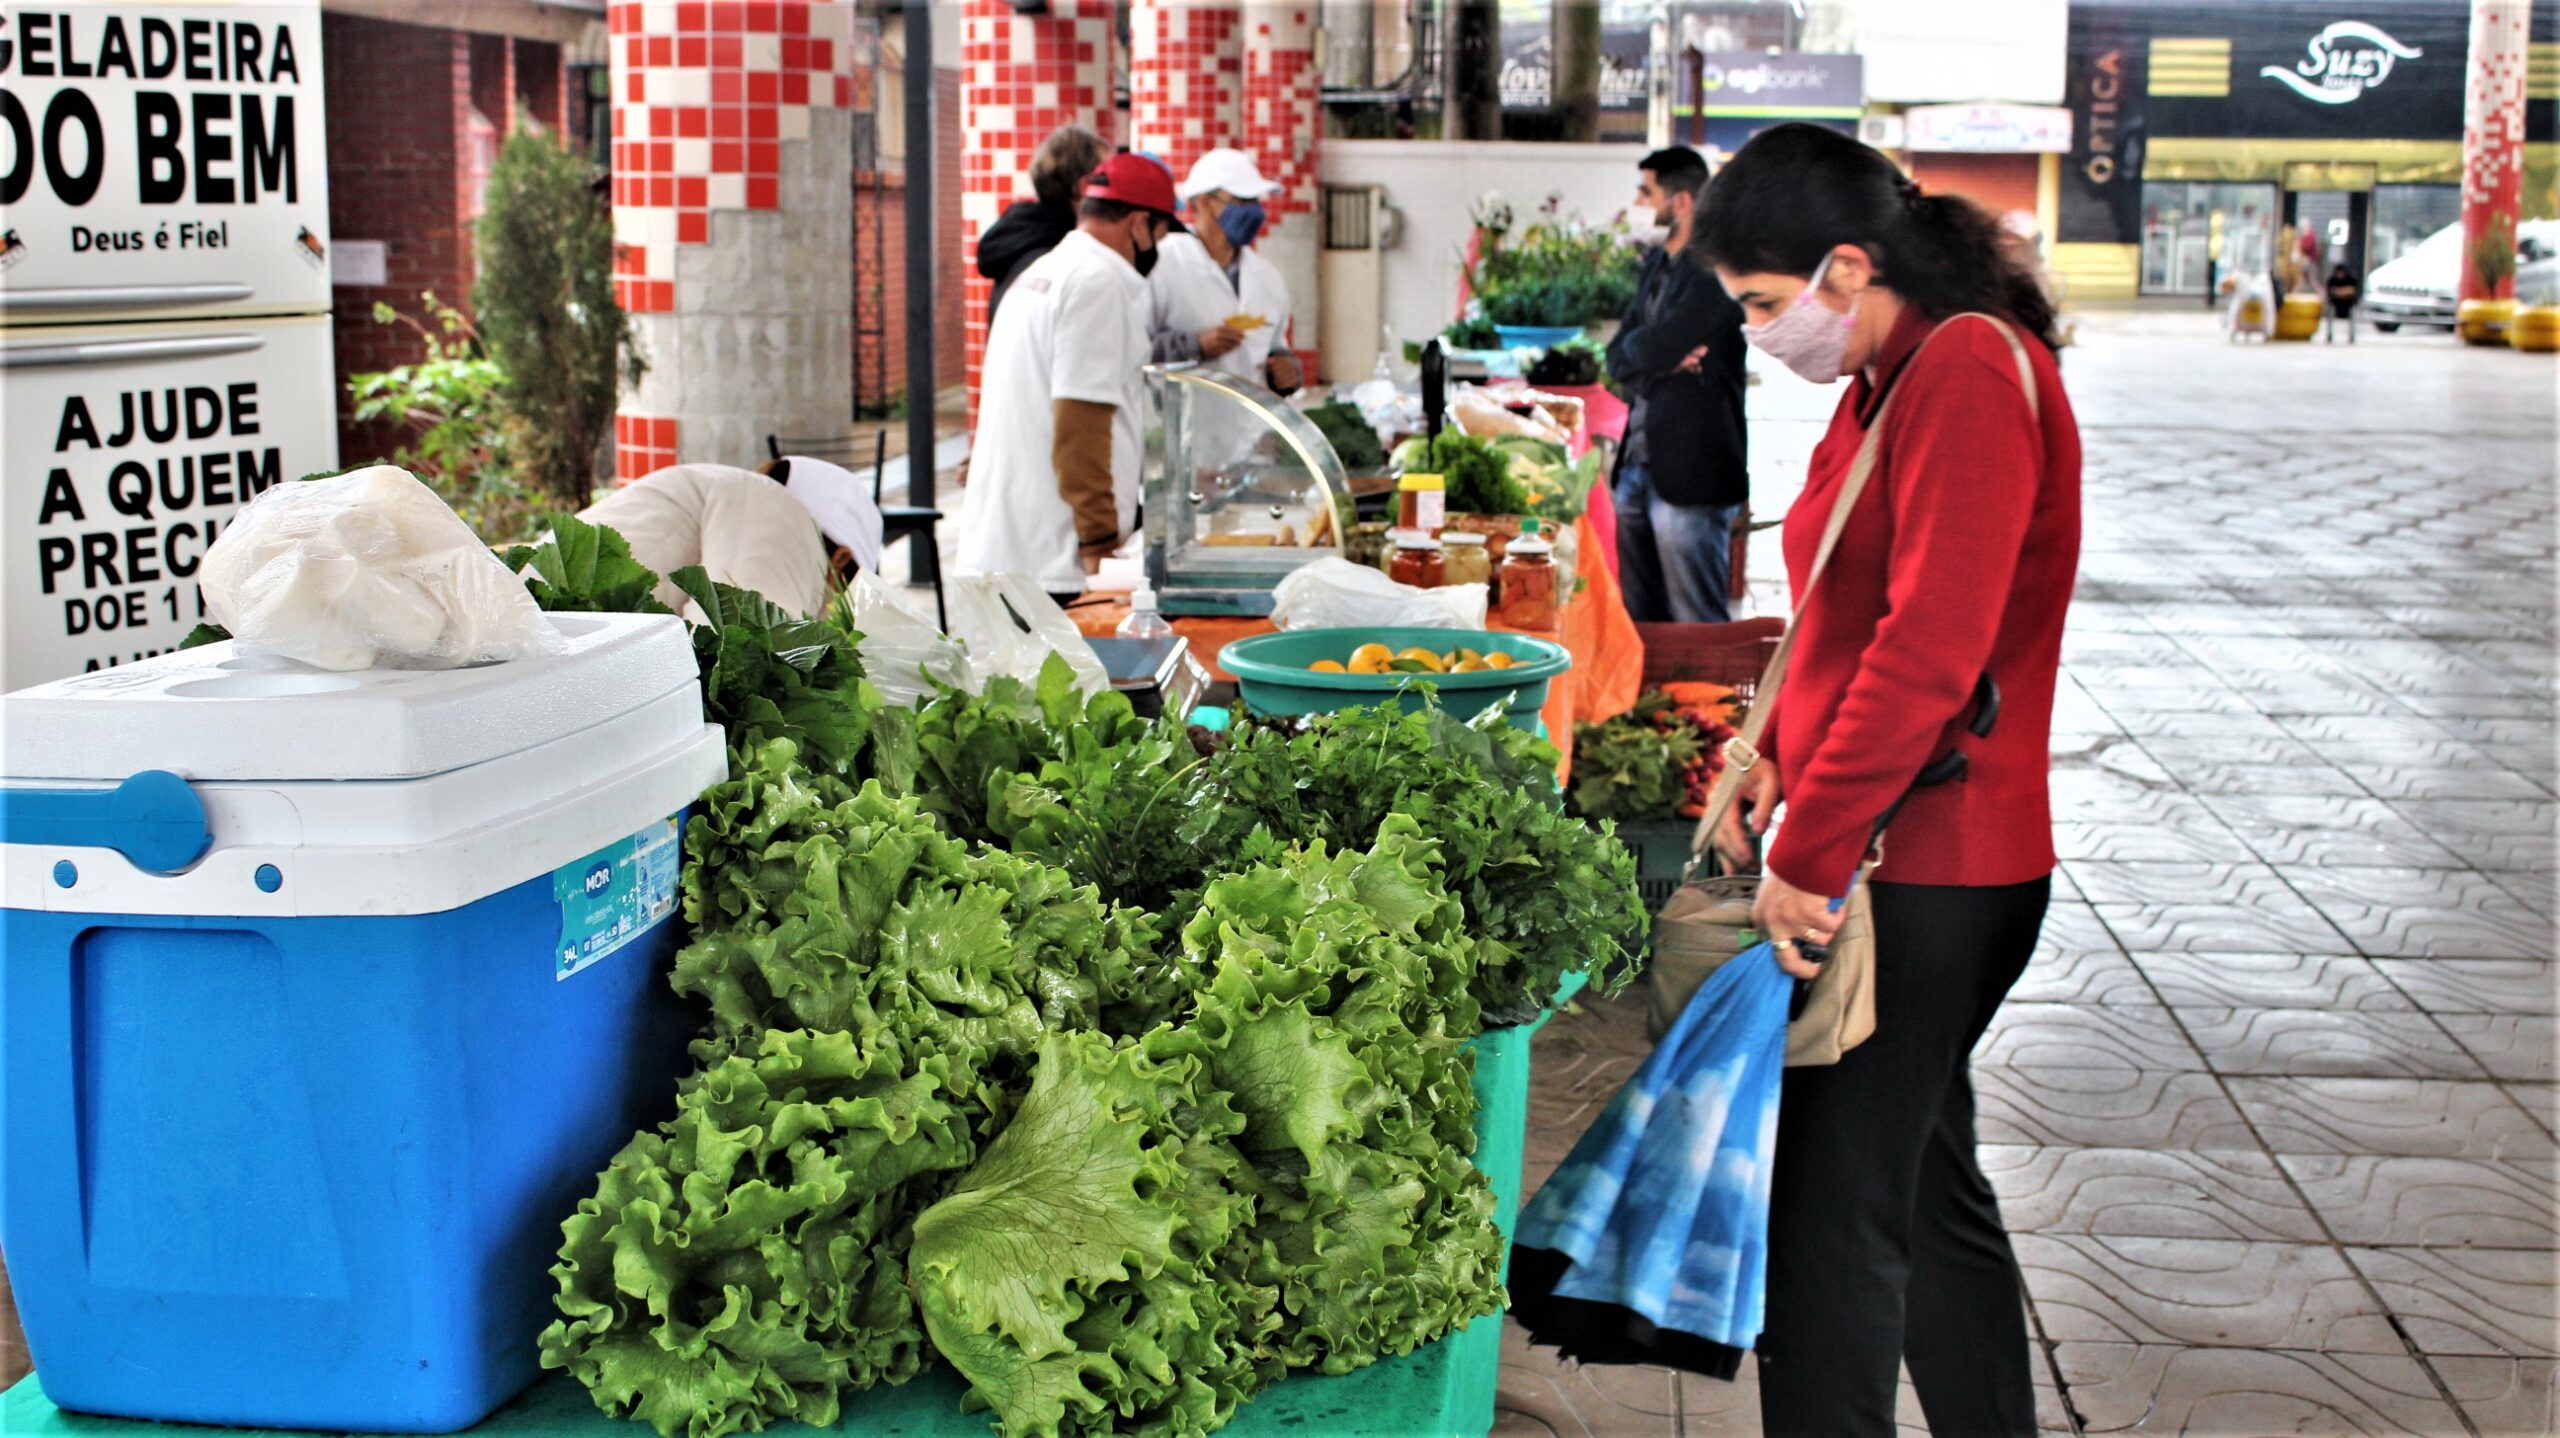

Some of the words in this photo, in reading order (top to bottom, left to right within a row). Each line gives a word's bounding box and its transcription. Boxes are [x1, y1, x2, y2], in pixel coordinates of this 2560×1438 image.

[2296, 30, 2397, 88] Suzy
[0, 87, 104, 206] DO
[135, 91, 298, 204] BEM
[71, 226, 144, 252] Deus
[154, 222, 169, 248] é
[179, 220, 228, 248] Fiel
[54, 382, 260, 452] AJUDE
[38, 468, 86, 525] A
[108, 447, 282, 520] QUEM
[38, 516, 235, 594] PREC
[65, 591, 147, 635] DOE
[163, 586, 178, 621] 1
[585, 868, 610, 893] MOR
[563, 945, 578, 964] 34L
